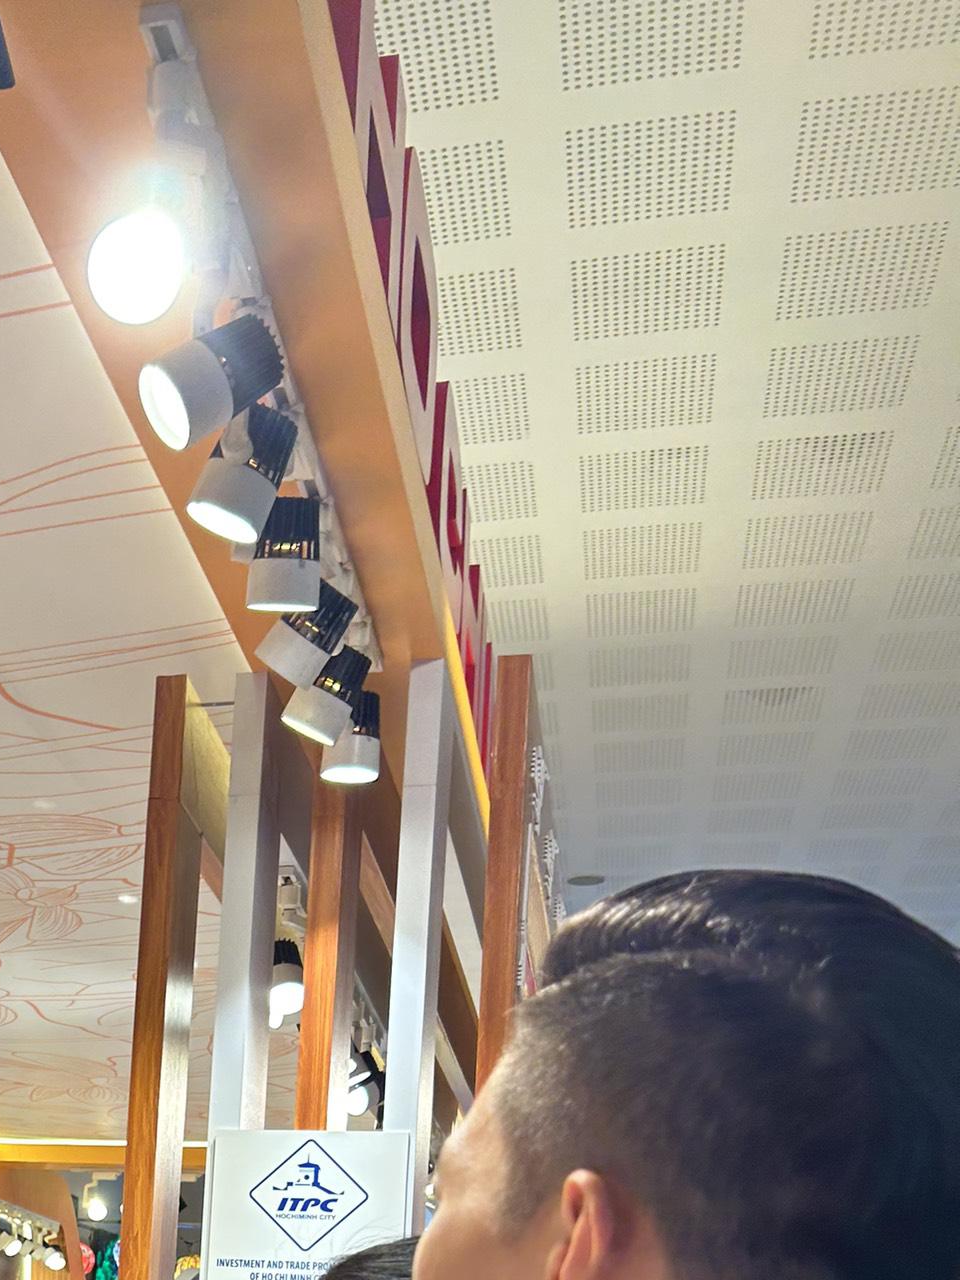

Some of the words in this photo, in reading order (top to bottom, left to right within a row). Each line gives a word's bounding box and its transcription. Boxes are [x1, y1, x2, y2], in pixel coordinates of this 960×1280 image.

[277, 1197, 339, 1213] ITPC
[216, 1258, 266, 1269] INVESTMENT
[266, 1260, 284, 1269] AND
[286, 1261, 310, 1271] TRADE
[249, 1272, 260, 1280] OF
